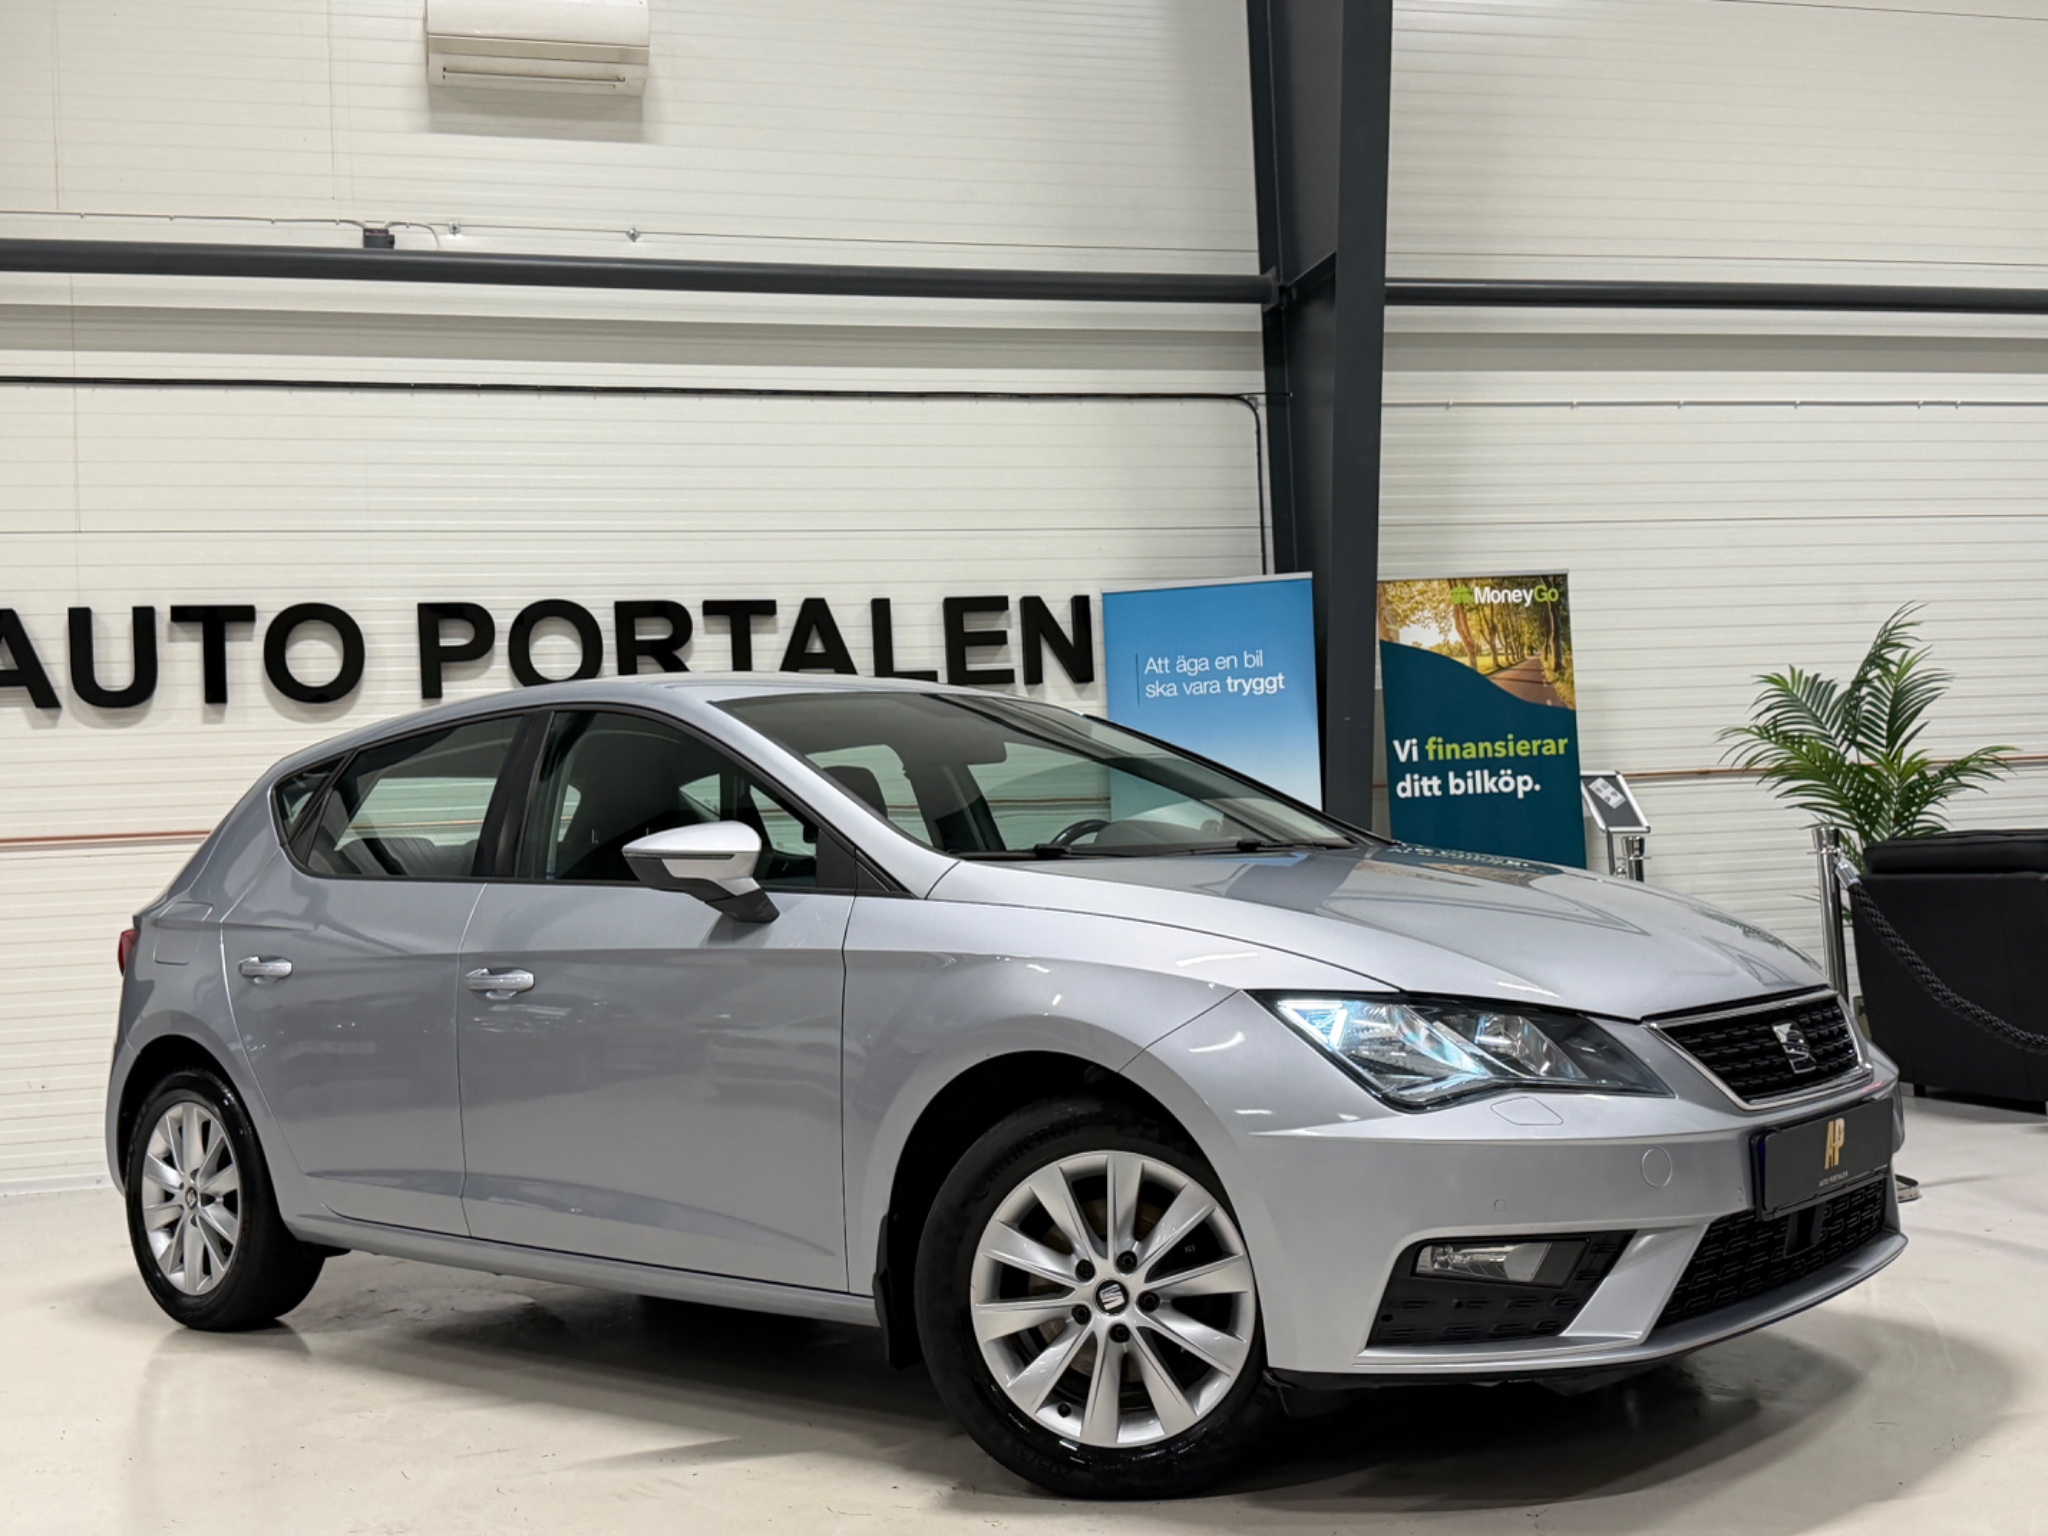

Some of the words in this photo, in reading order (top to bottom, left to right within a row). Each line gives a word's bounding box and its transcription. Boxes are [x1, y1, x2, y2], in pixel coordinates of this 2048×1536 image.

[1474, 584, 1559, 607] MoneyGo
[417, 595, 1094, 699] PORTALEN
[1144, 656, 1171, 675] Att
[1175, 654, 1210, 677] äga
[1214, 655, 1238, 671] en
[1243, 649, 1264, 669] bil
[1145, 680, 1179, 699] ska
[1182, 679, 1222, 696] vara
[1226, 672, 1286, 697] tryggt
[1392, 738, 1420, 763] Vi
[1425, 734, 1569, 762] finansierar
[1396, 773, 1442, 799] ditt
[1448, 768, 1541, 799] bilköp.
